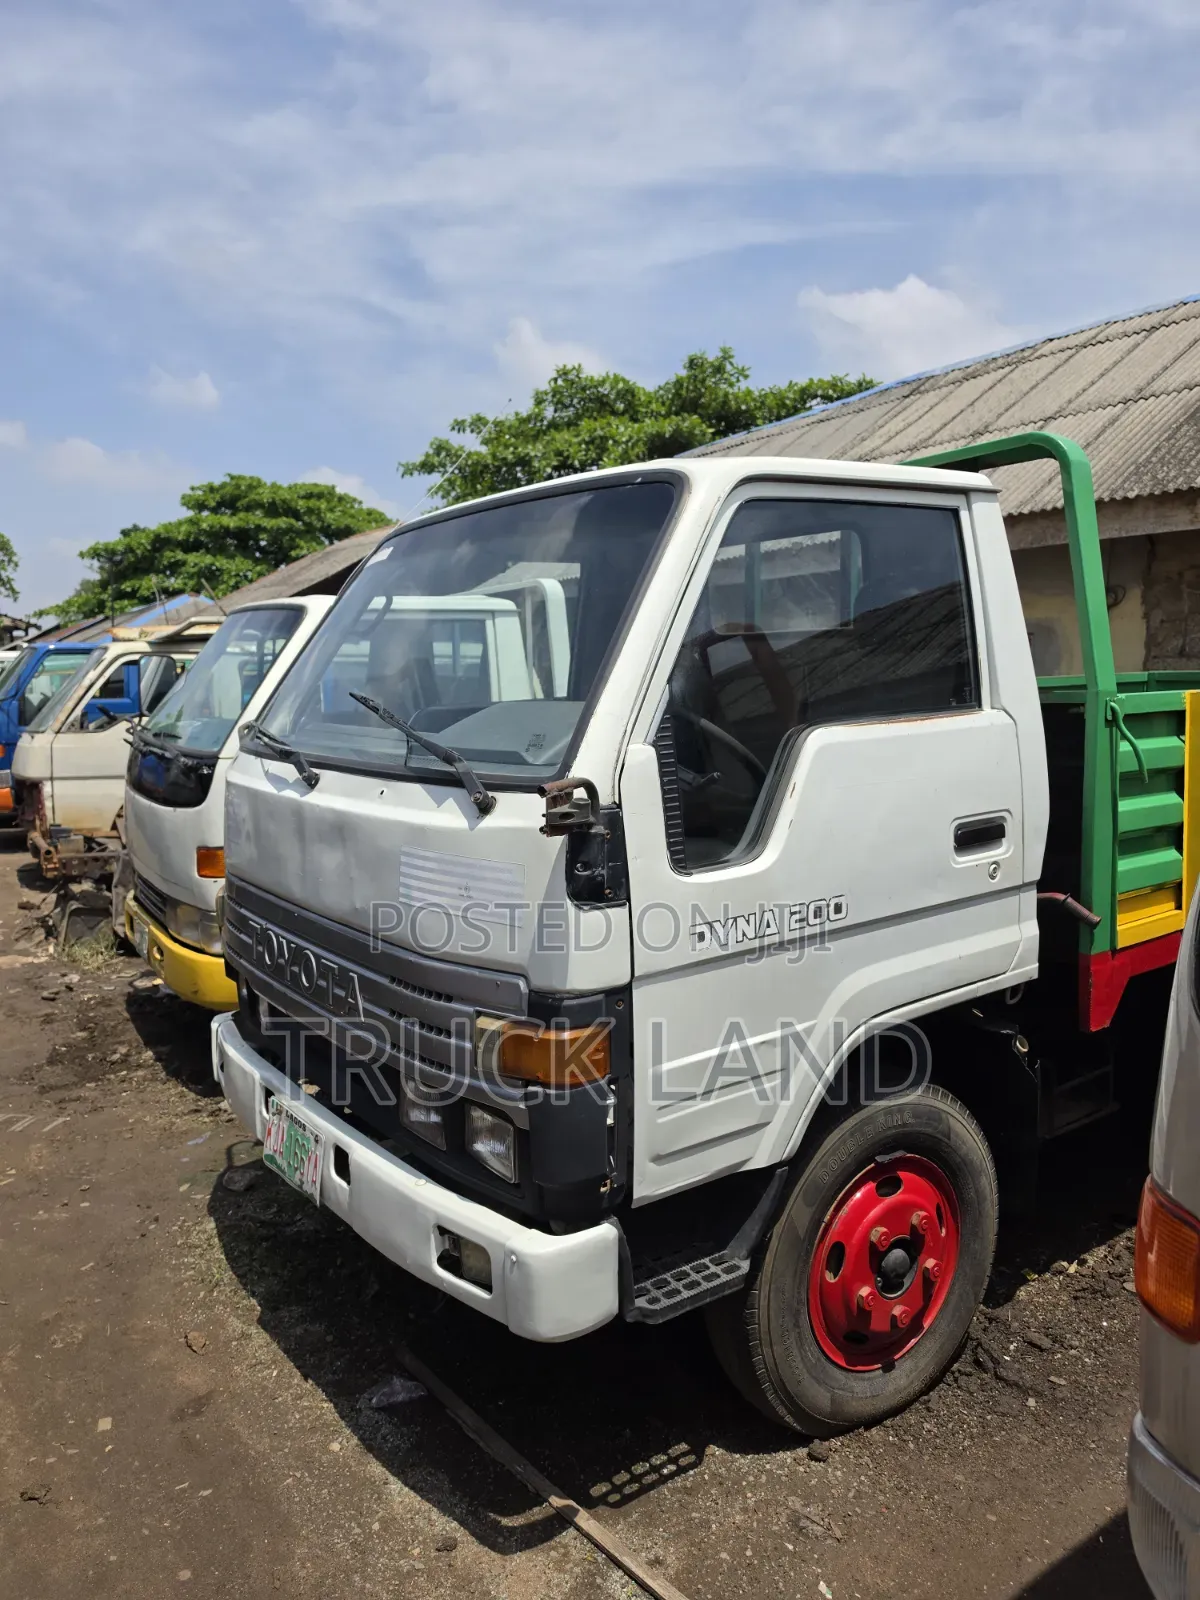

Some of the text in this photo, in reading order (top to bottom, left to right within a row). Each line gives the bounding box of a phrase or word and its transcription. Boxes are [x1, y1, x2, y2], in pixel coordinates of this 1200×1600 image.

[689, 894, 848, 951] DYNA 200
[248, 920, 365, 1024] TOYOTA
[285, 1110, 307, 1132] LAGOS
[818, 1110, 915, 1184] DOUBLE KING
